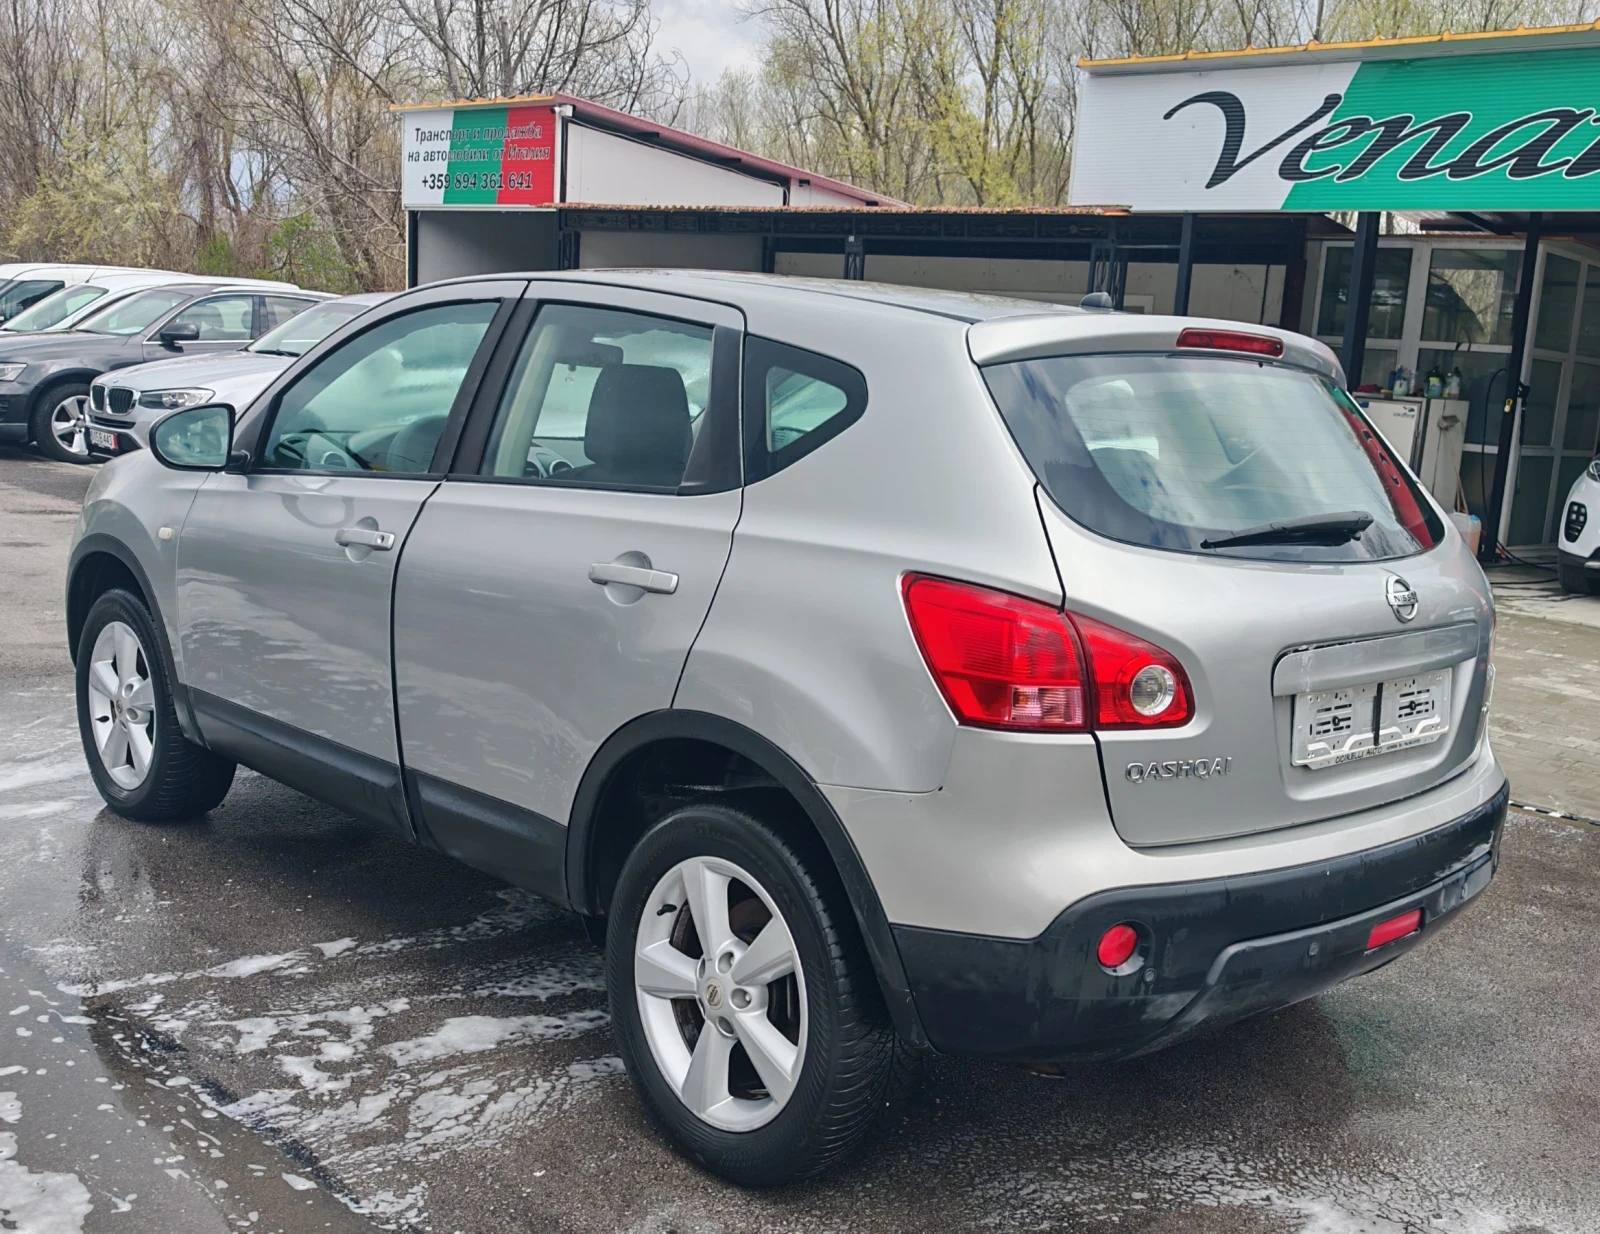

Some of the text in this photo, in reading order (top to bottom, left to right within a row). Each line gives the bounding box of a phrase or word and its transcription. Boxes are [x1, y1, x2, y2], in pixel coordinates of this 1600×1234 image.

[415, 122, 542, 145] Транспорт и продажба
[408, 144, 550, 162] на автомобили от Италия
[422, 171, 533, 190] +359 894 361 641
[1125, 756, 1232, 783] QASHQAI
